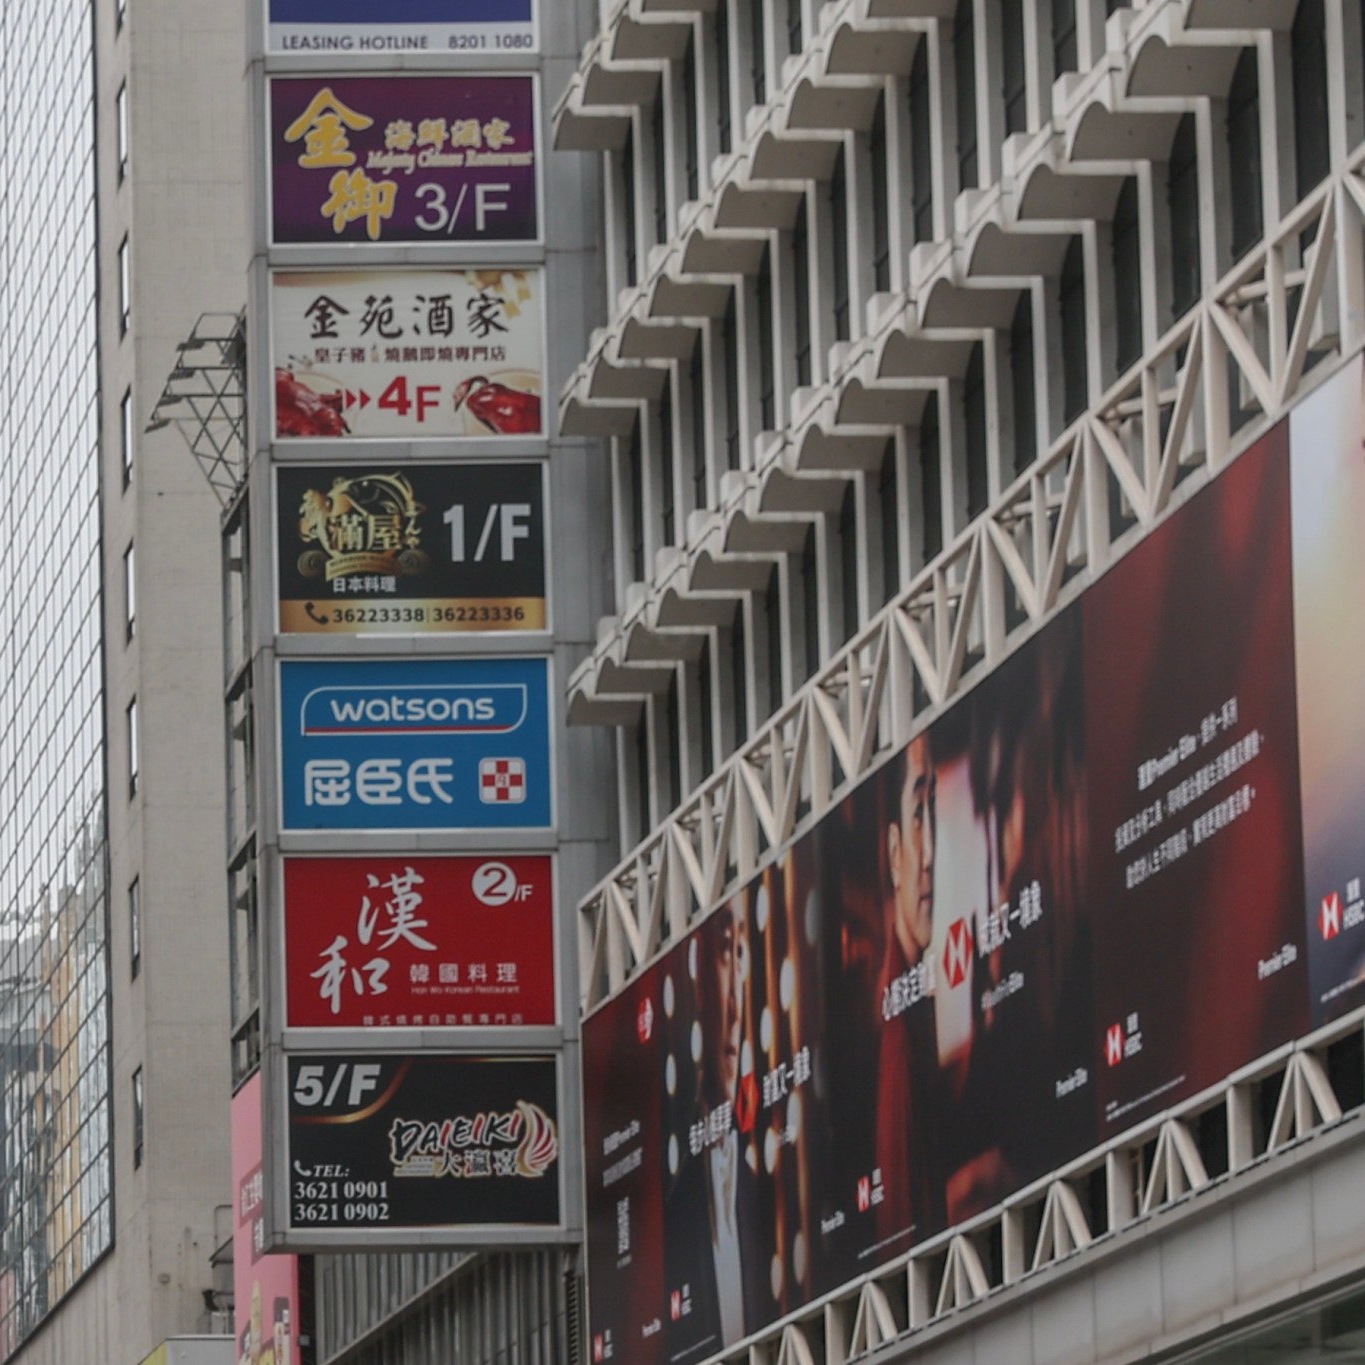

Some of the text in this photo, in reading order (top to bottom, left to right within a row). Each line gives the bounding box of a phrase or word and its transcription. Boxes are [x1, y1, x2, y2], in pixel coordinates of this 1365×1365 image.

[282, 34, 533, 51] LEASING HOTLINE 8201 1080
[464, 149, 533, 168] Restaurant
[414, 184, 511, 235] 3/F
[304, 294, 510, 340] 金苑酒家
[377, 376, 441, 423] 4F
[442, 504, 532, 562] 1/F
[332, 576, 397, 593] 日本料理
[330, 695, 495, 723] watsons
[303, 758, 454, 806] 屈臣氏
[478, 866, 533, 902] 2/F
[309, 866, 438, 1015] 漢和
[410, 963, 518, 984] 韓國料理
[475, 985, 520, 995] Restaurant
[293, 1063, 382, 1106] 5/F
[390, 1109, 522, 1165] DAIEIKI
[312, 1163, 351, 1178] TEL:
[294, 1182, 388, 1200] 3621 0901
[294, 1204, 389, 1222] 3621 0902
